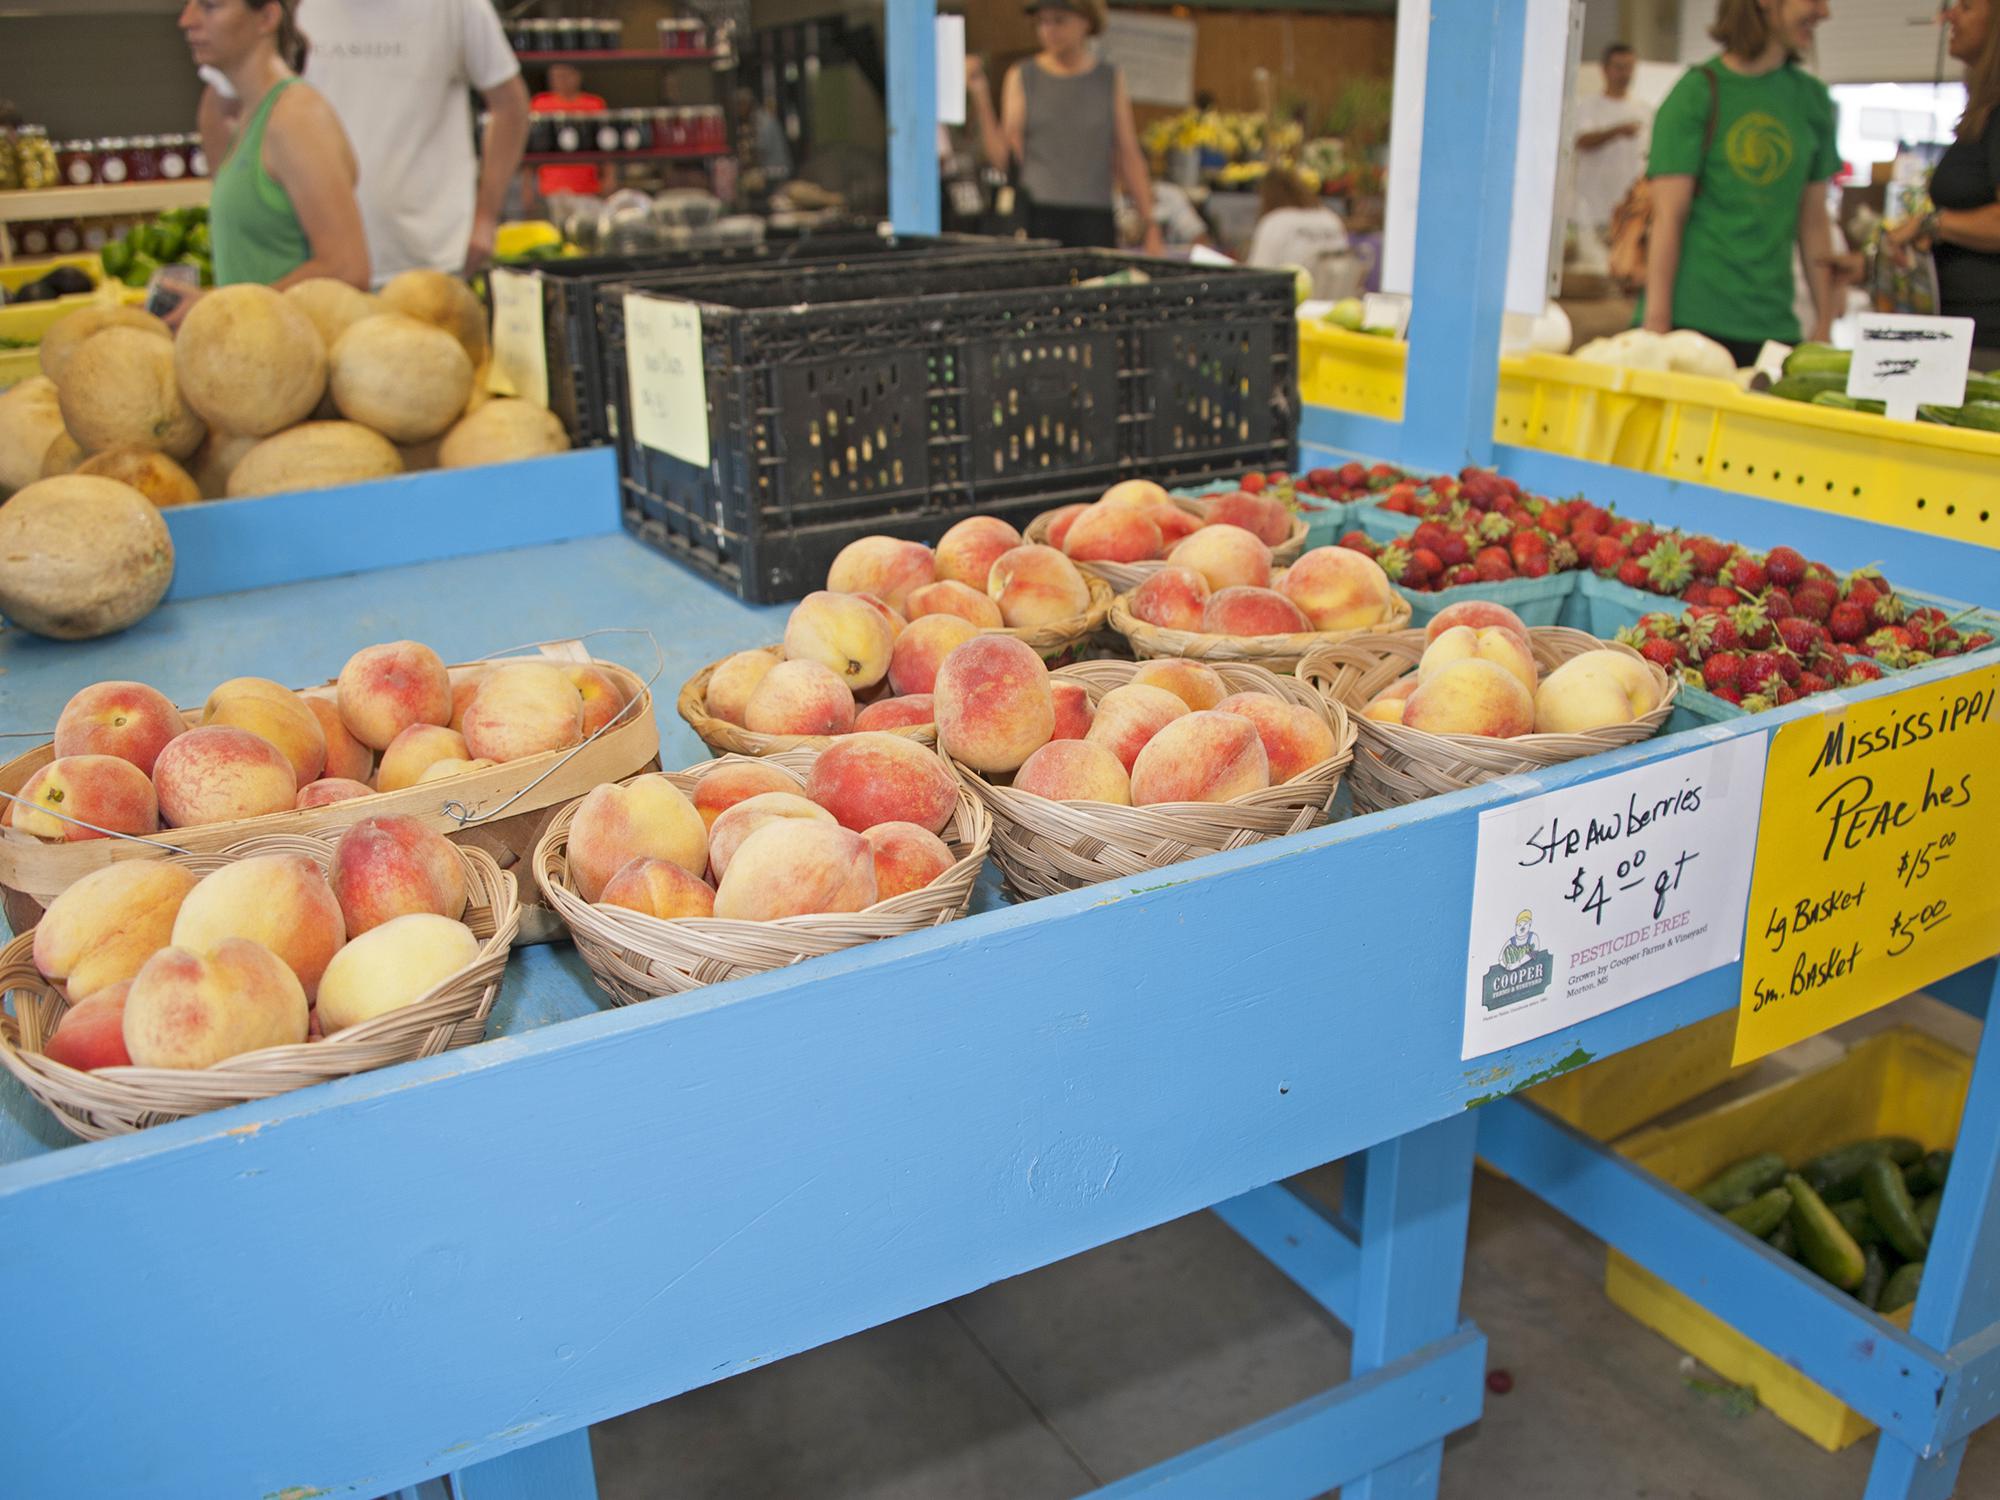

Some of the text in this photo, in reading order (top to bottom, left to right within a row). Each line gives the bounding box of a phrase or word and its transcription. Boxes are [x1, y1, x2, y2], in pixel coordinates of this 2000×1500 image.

[312, 42, 409, 59] EASIDE
[1567, 924, 1709, 985] Grown by Cooper Farms & Vineyard
[1569, 911, 1691, 969] PESTICIDE FREE
[1493, 963, 1544, 992] COOPER
[1566, 976, 1609, 998] Morton, MS
